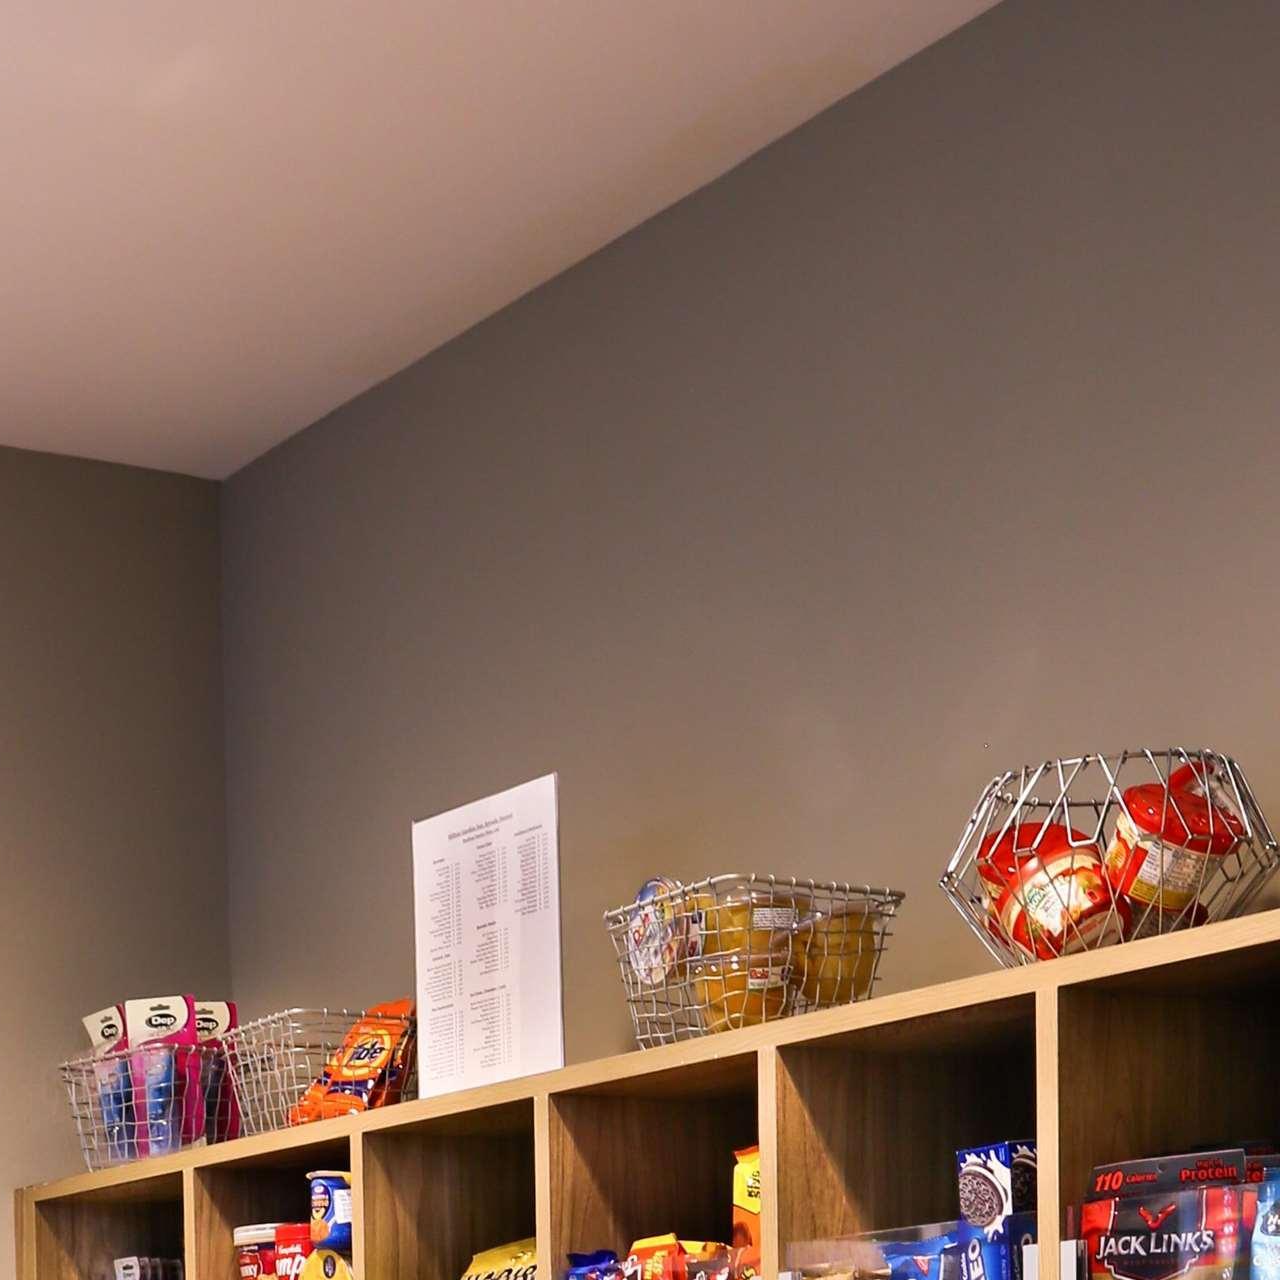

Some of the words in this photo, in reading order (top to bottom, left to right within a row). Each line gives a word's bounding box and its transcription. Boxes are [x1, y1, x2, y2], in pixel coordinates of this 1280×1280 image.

[151, 1016, 176, 1026] Dep
[1095, 1170, 1123, 1192] 110
[1180, 1167, 1238, 1183] Protein
[1096, 1236, 1147, 1259] JACK
